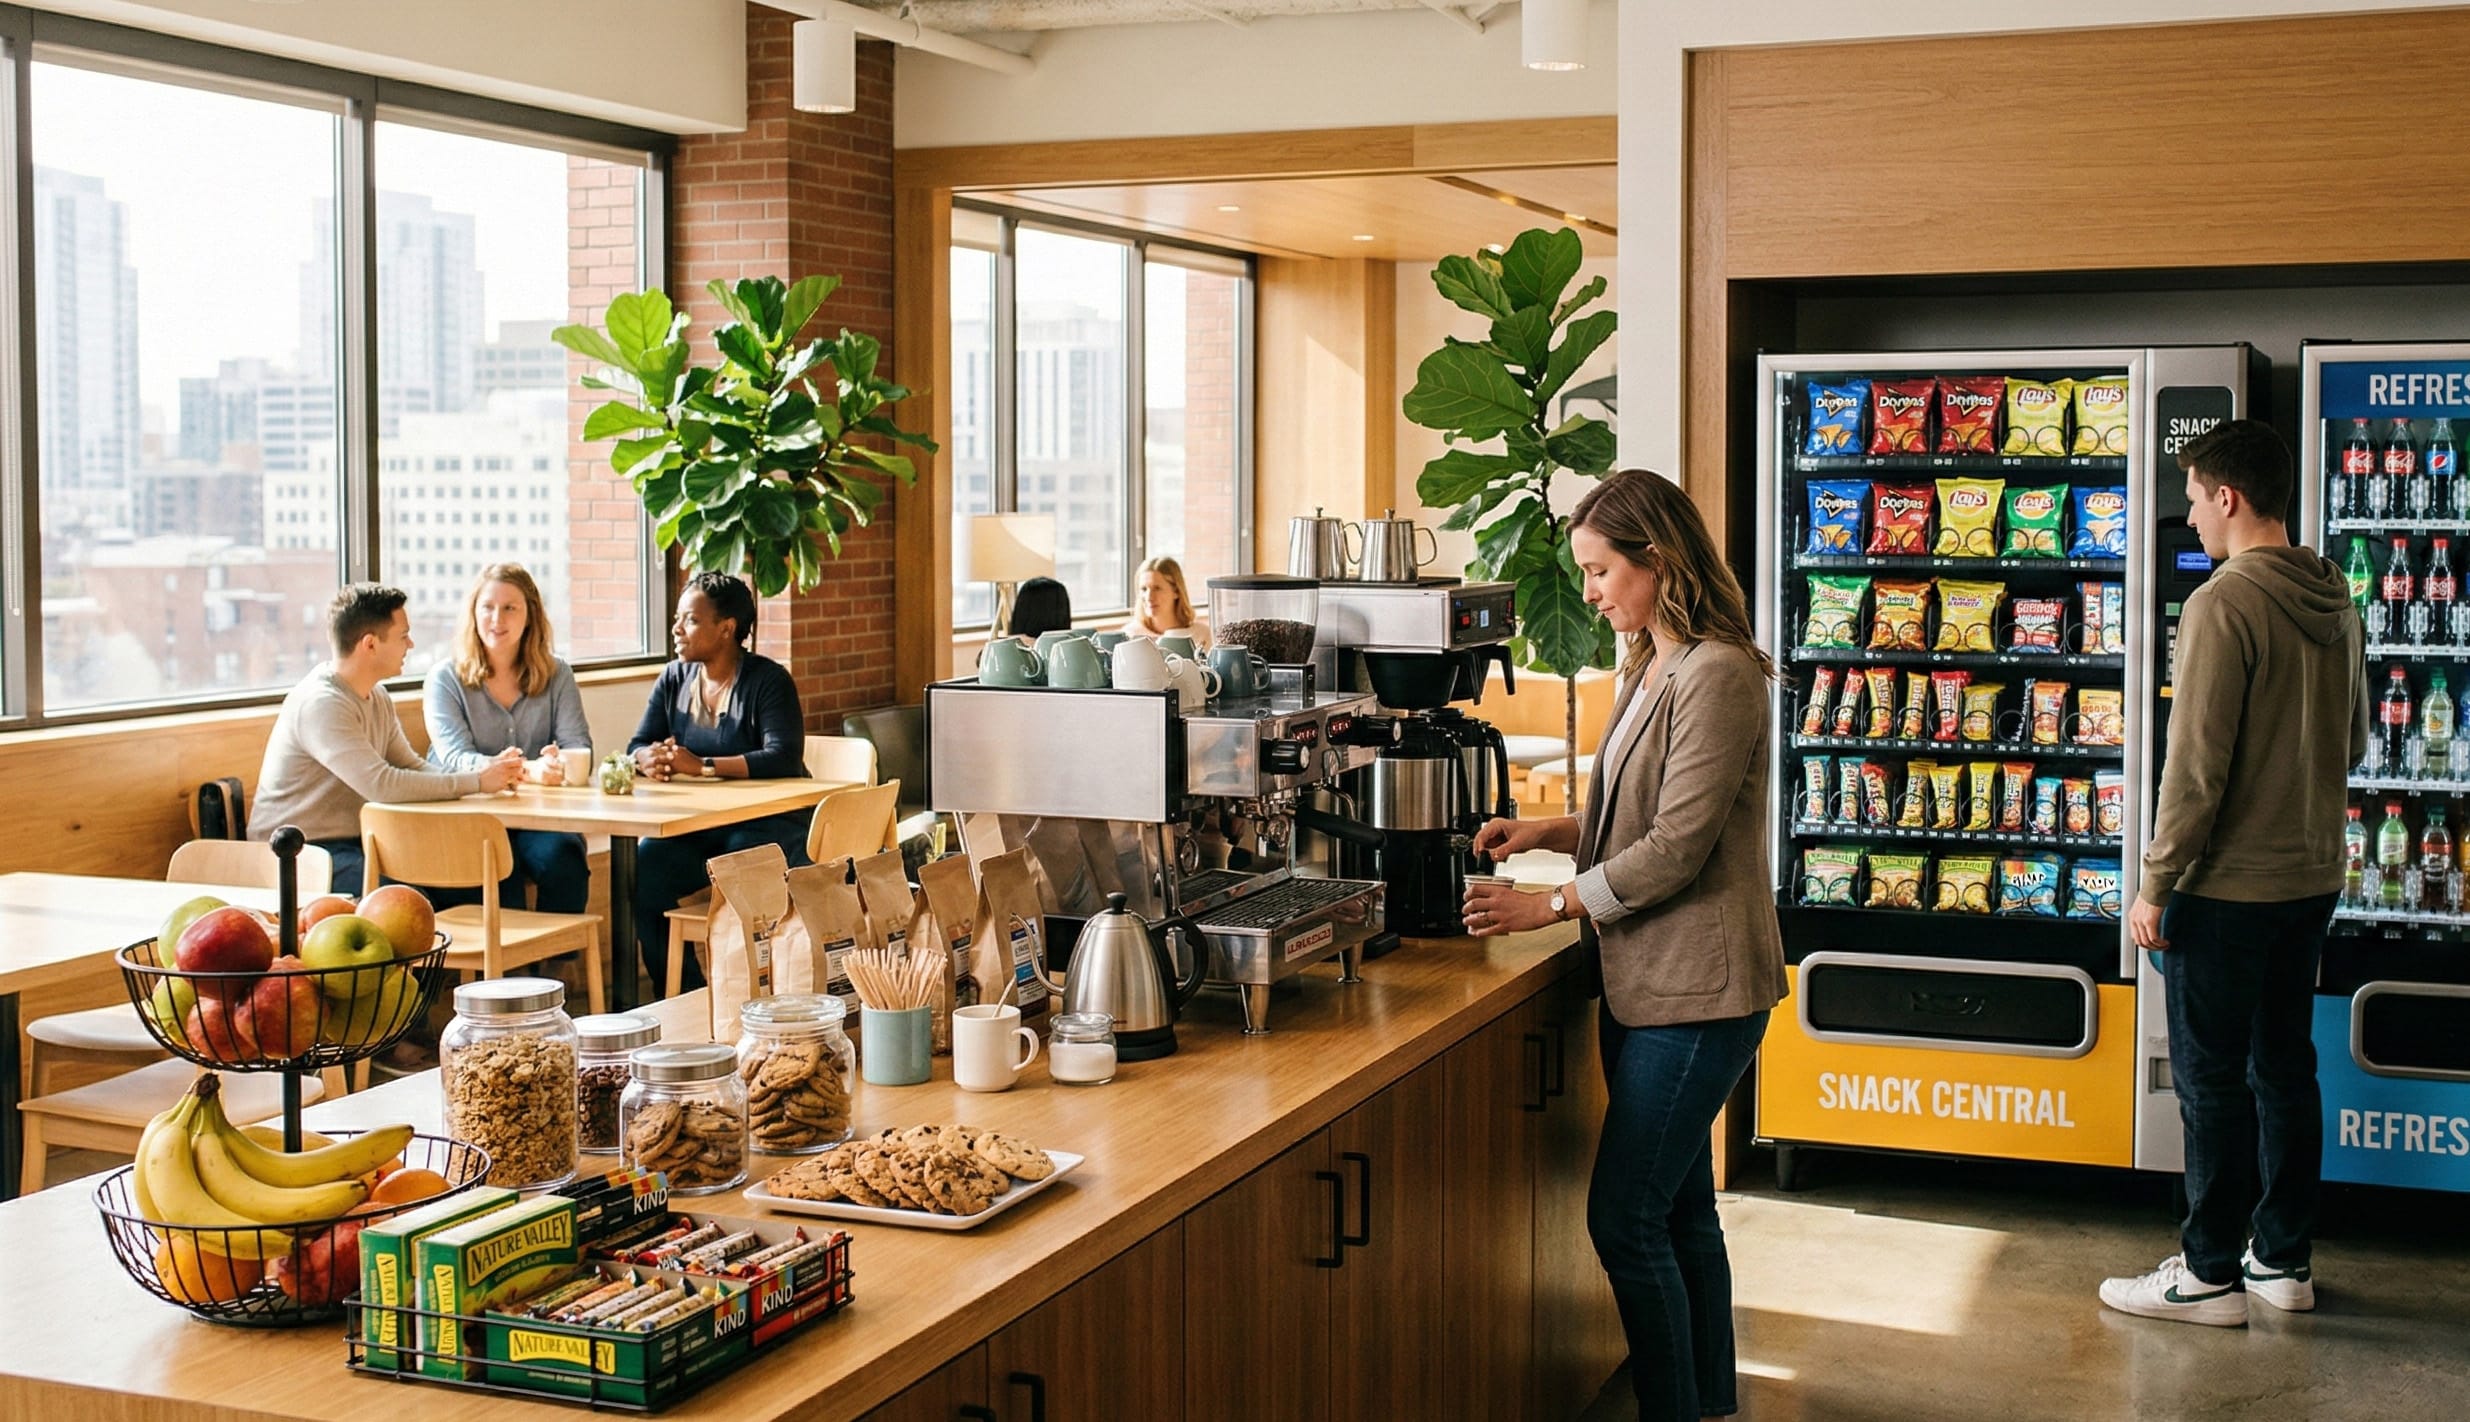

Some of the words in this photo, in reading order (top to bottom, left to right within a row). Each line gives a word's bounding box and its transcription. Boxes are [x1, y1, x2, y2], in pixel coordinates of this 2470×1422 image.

[1818, 1072, 1922, 1115] SNACK
[1932, 1080, 2075, 1128] CENTRAL
[2339, 1108, 2470, 1156] REFRES
[633, 1187, 668, 1215] KIND
[471, 1232, 522, 1281] NATURE
[523, 1213, 569, 1246] VALLEY
[762, 1284, 793, 1315] KIND
[714, 1308, 746, 1338] KIND
[513, 1332, 564, 1356] NATURE
